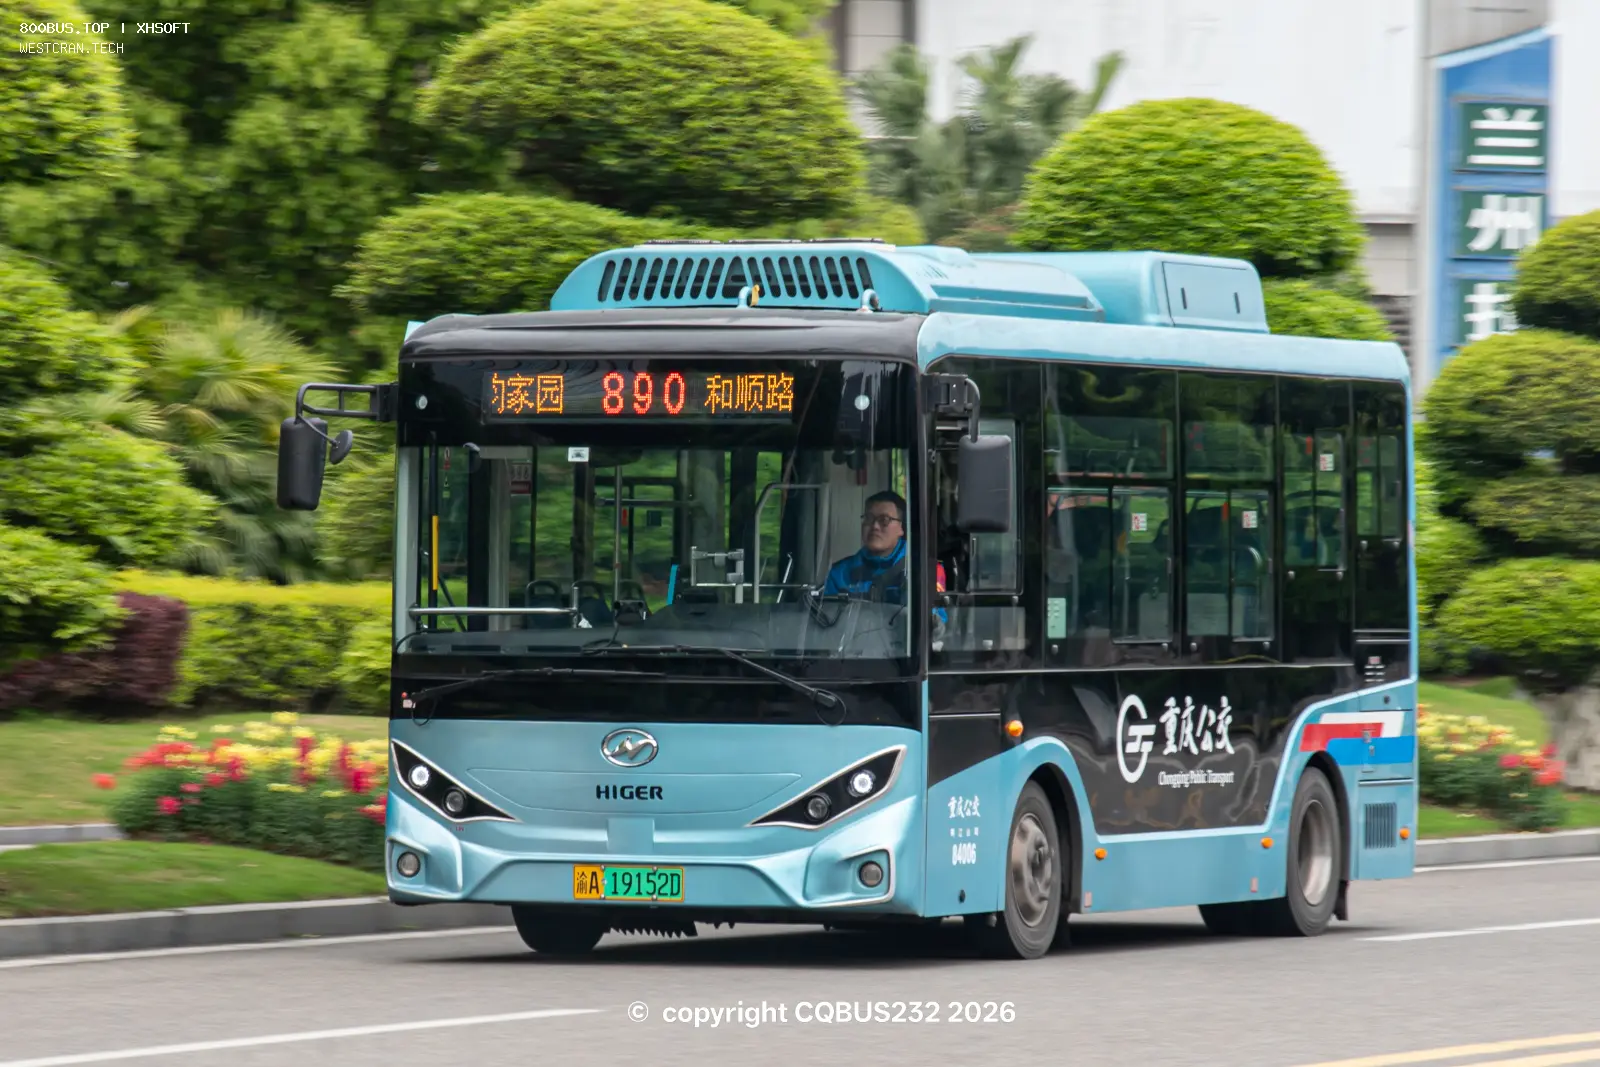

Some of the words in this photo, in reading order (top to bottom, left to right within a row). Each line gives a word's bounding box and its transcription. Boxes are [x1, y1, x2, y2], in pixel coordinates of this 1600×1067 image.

[602, 371, 686, 415] 890
[704, 372, 795, 414] 和顺路
[1159, 695, 1235, 755] 重庆公交
[596, 784, 664, 801] HIGER
